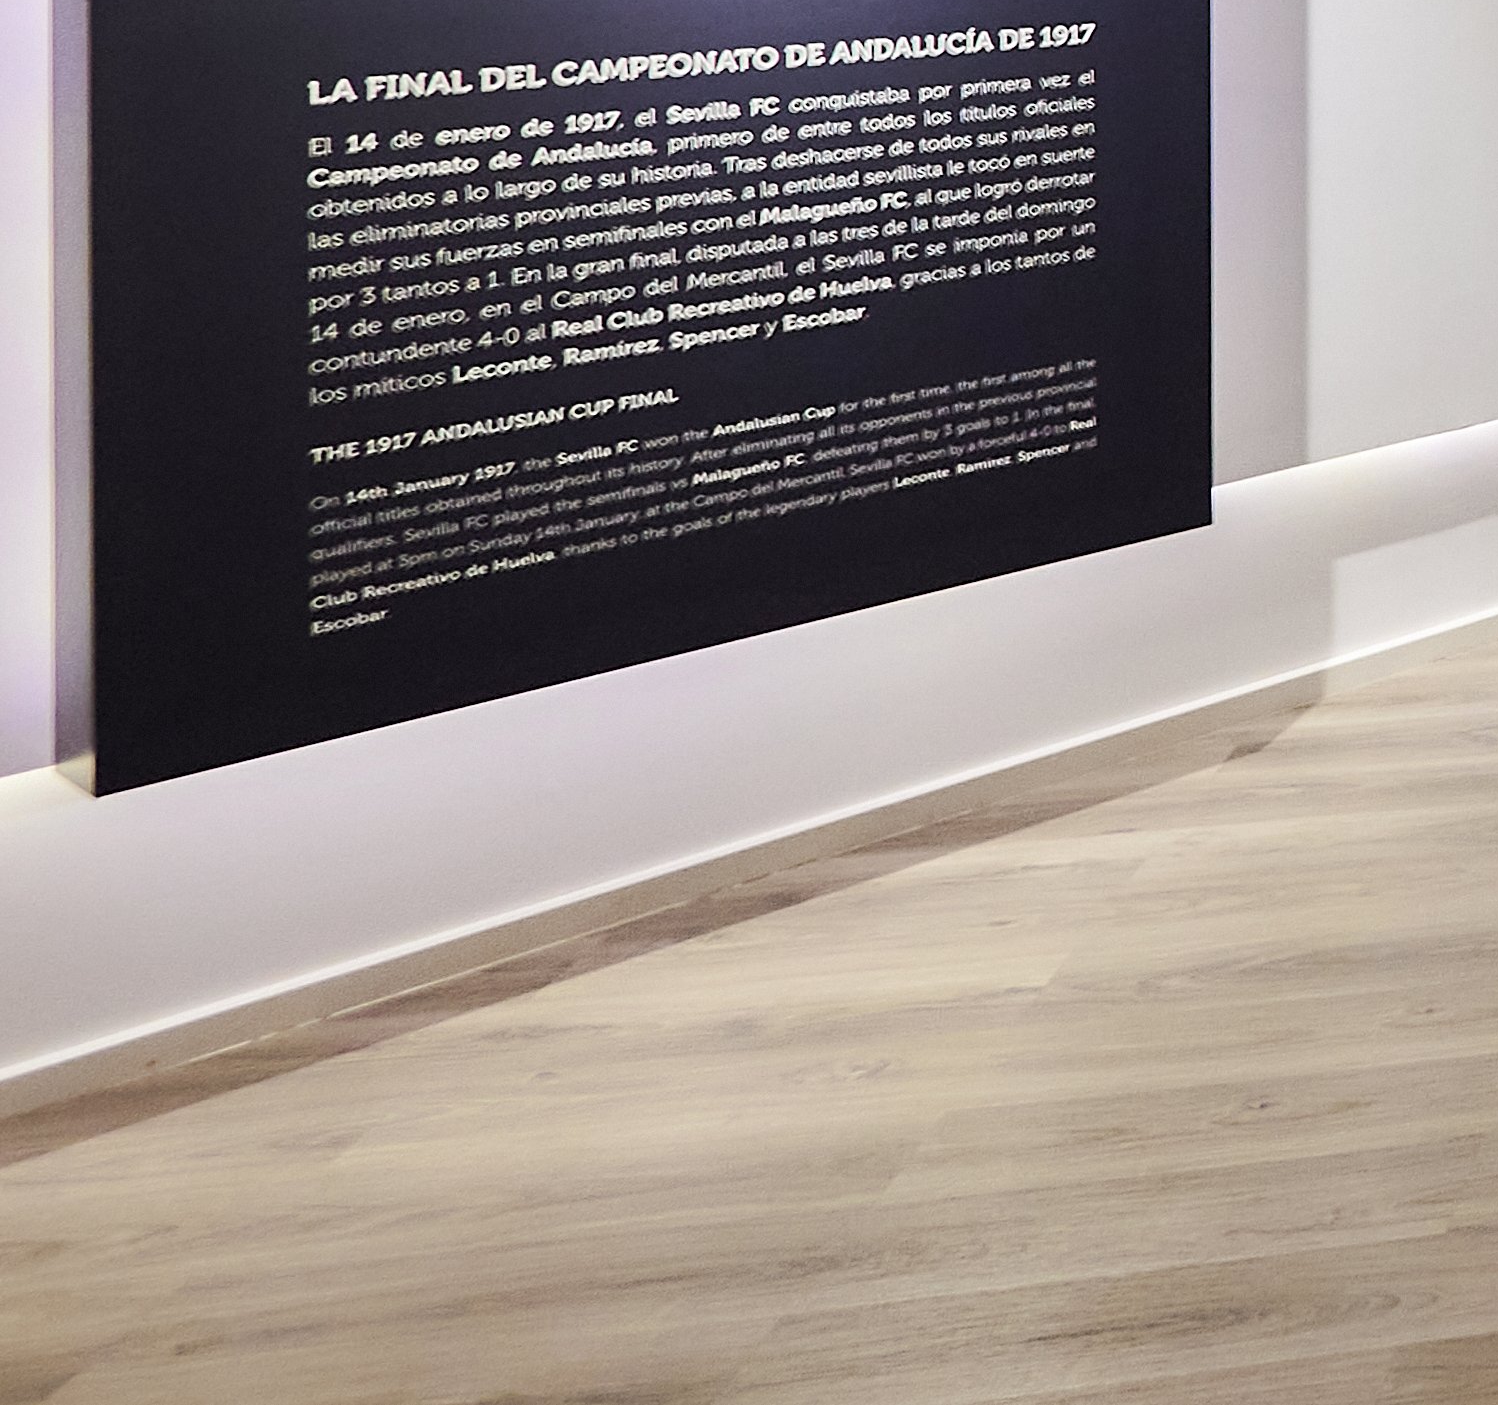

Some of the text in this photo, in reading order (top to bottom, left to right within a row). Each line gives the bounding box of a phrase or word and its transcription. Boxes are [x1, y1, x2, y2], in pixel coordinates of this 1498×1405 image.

[307, 22, 1097, 105] LA FINAL DEL CAMPEONATO DE ANDALUCÍA DE 1917
[306, 156, 480, 188] Campeonato
[488, 150, 523, 171] de
[667, 130, 754, 157] primero
[761, 124, 790, 144] de
[797, 120, 852, 140] entre
[859, 113, 917, 134] todos
[922, 109, 953, 127] los
[1023, 95, 1096, 117] oficiales
[308, 69, 1095, 157] El 14 de enero de 1917, el Sevilla FC conquistaba por primera vez el
[307, 122, 1096, 218] obtenidos a lo largo de su historia. Tras deshacerse de todos sus rivales en
[308, 232, 344, 250] las
[349, 213, 510, 244] eliminatorias
[514, 196, 652, 231] provinciales
[740, 185, 756, 201] a
[758, 180, 780, 199] la
[782, 170, 860, 196] entidad
[863, 163, 944, 187] sevillista
[946, 159, 965, 177] le
[967, 154, 1011, 174] tocó
[1013, 153, 1038, 169] en
[1040, 146, 1096, 167] suerte
[308, 256, 386, 281] medir
[389, 252, 432, 271] sus
[436, 241, 524, 265] fuerzas
[527, 237, 560, 255] en
[562, 220, 688, 249] semifinales
[690, 216, 734, 235] con
[735, 209, 757, 229] el
[758, 196, 878, 227] Malagueño
[913, 188, 933, 207] al
[934, 187, 972, 206] que
[973, 178, 1023, 201] logró
[1024, 172, 1096, 193] derrotar
[308, 293, 354, 315] por
[360, 286, 377, 305] 3
[381, 279, 461, 301] tantos
[465, 276, 481, 292] a
[511, 266, 542, 286] En
[546, 263, 569, 282] la
[571, 258, 625, 282] gran
[685, 234, 789, 263] disputada
[791, 234, 807, 250] a
[809, 229, 839, 247] las
[841, 224, 879, 242] tres
[881, 218, 908, 237] de
[910, 216, 929, 234] la
[932, 209, 981, 230] tarde
[983, 204, 1013, 224] del
[1015, 197, 1097, 220] domingo
[308, 337, 473, 373] contundente
[477, 326, 521, 347] 4-0
[524, 323, 547, 342] al
[550, 314, 604, 339] Real
[606, 307, 664, 331] Club
[667, 292, 785, 322] Recreativo
[787, 285, 816, 305] de
[899, 265, 967, 290] gracias
[969, 263, 982, 276] a
[984, 258, 1012, 274] los
[1014, 250, 1071, 270] tantos
[1072, 245, 1096, 261] de
[311, 322, 339, 343] 14
[349, 318, 383, 337] de
[391, 308, 470, 331] enero,
[479, 302, 512, 318] en
[520, 294, 543, 314] el
[550, 285, 636, 309] Campo
[643, 275, 679, 297] del
[795, 256, 816, 276] el
[822, 248, 885, 273] Sevilla
[892, 242, 919, 262] FC
[924, 242, 947, 257] se
[1034, 226, 1066, 244] por
[1071, 222, 1096, 237] un
[309, 386, 348, 404] los
[452, 355, 557, 384] Leconte,
[668, 323, 761, 352] Spencer
[763, 320, 779, 339] y
[309, 388, 680, 463] THE 1917 ANDALUSIAN CUP FINAL
